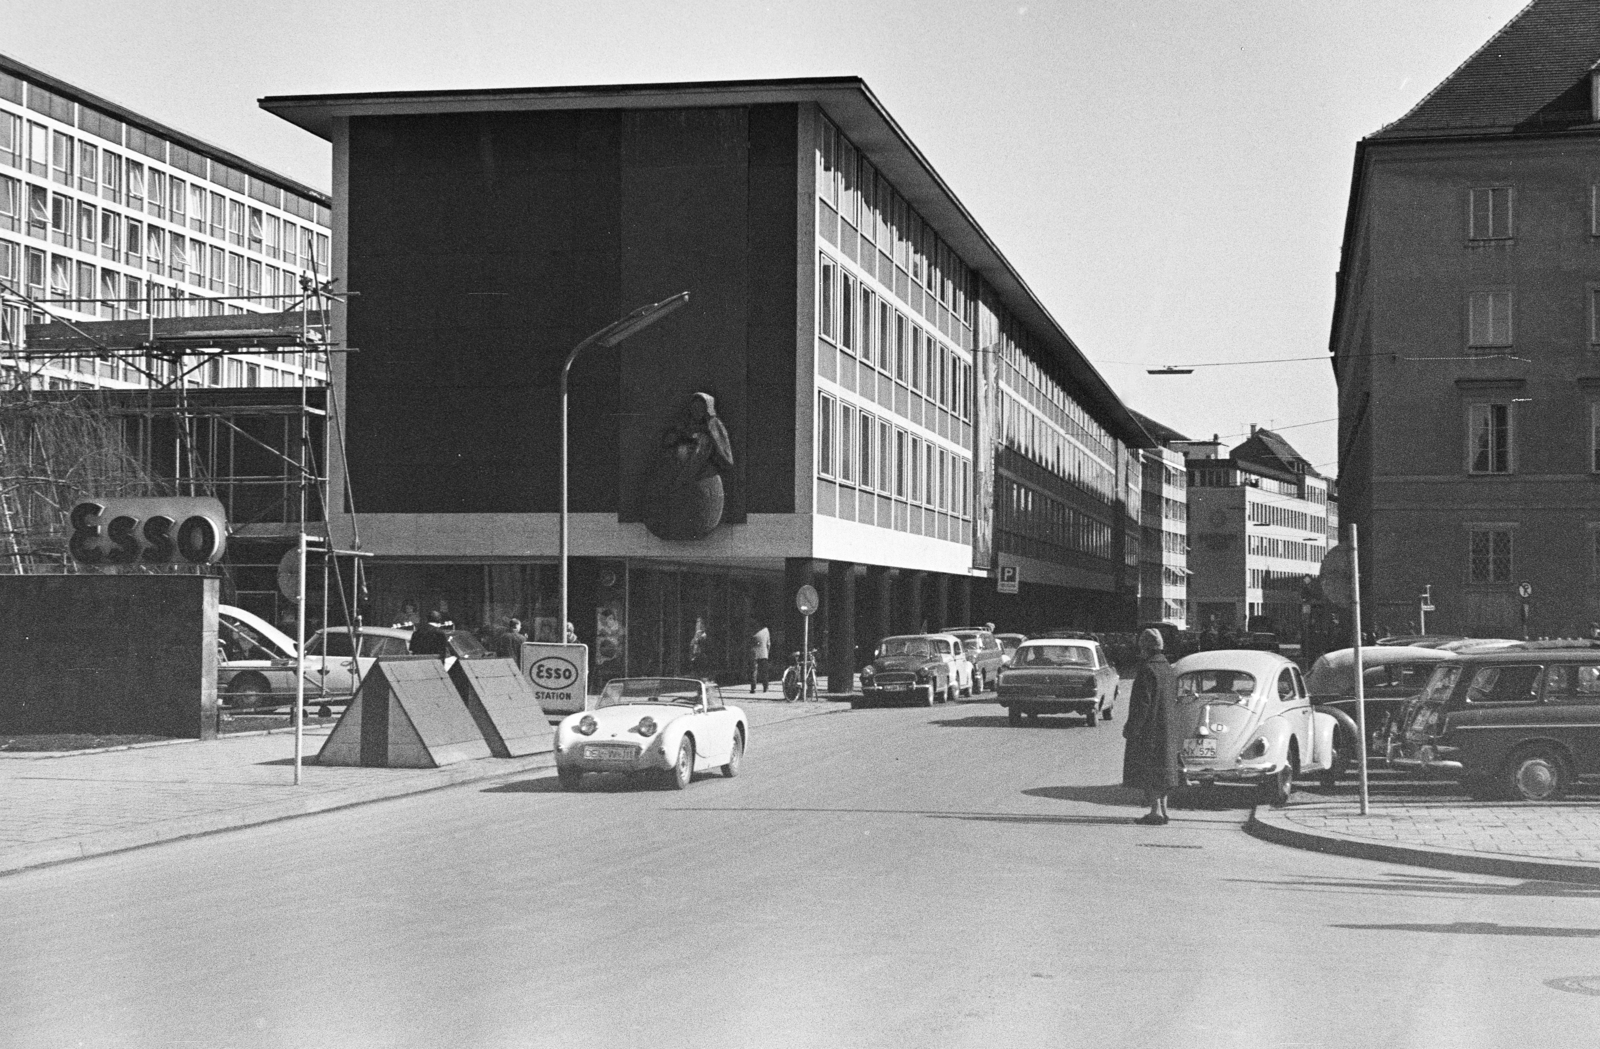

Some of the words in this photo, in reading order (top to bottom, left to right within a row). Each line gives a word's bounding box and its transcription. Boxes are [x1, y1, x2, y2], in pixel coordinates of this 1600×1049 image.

[1004, 567, 1013, 581] P
[535, 691, 572, 700] STATION
[1216, 723, 1223, 731] D
[1199, 747, 1215, 755] 575
